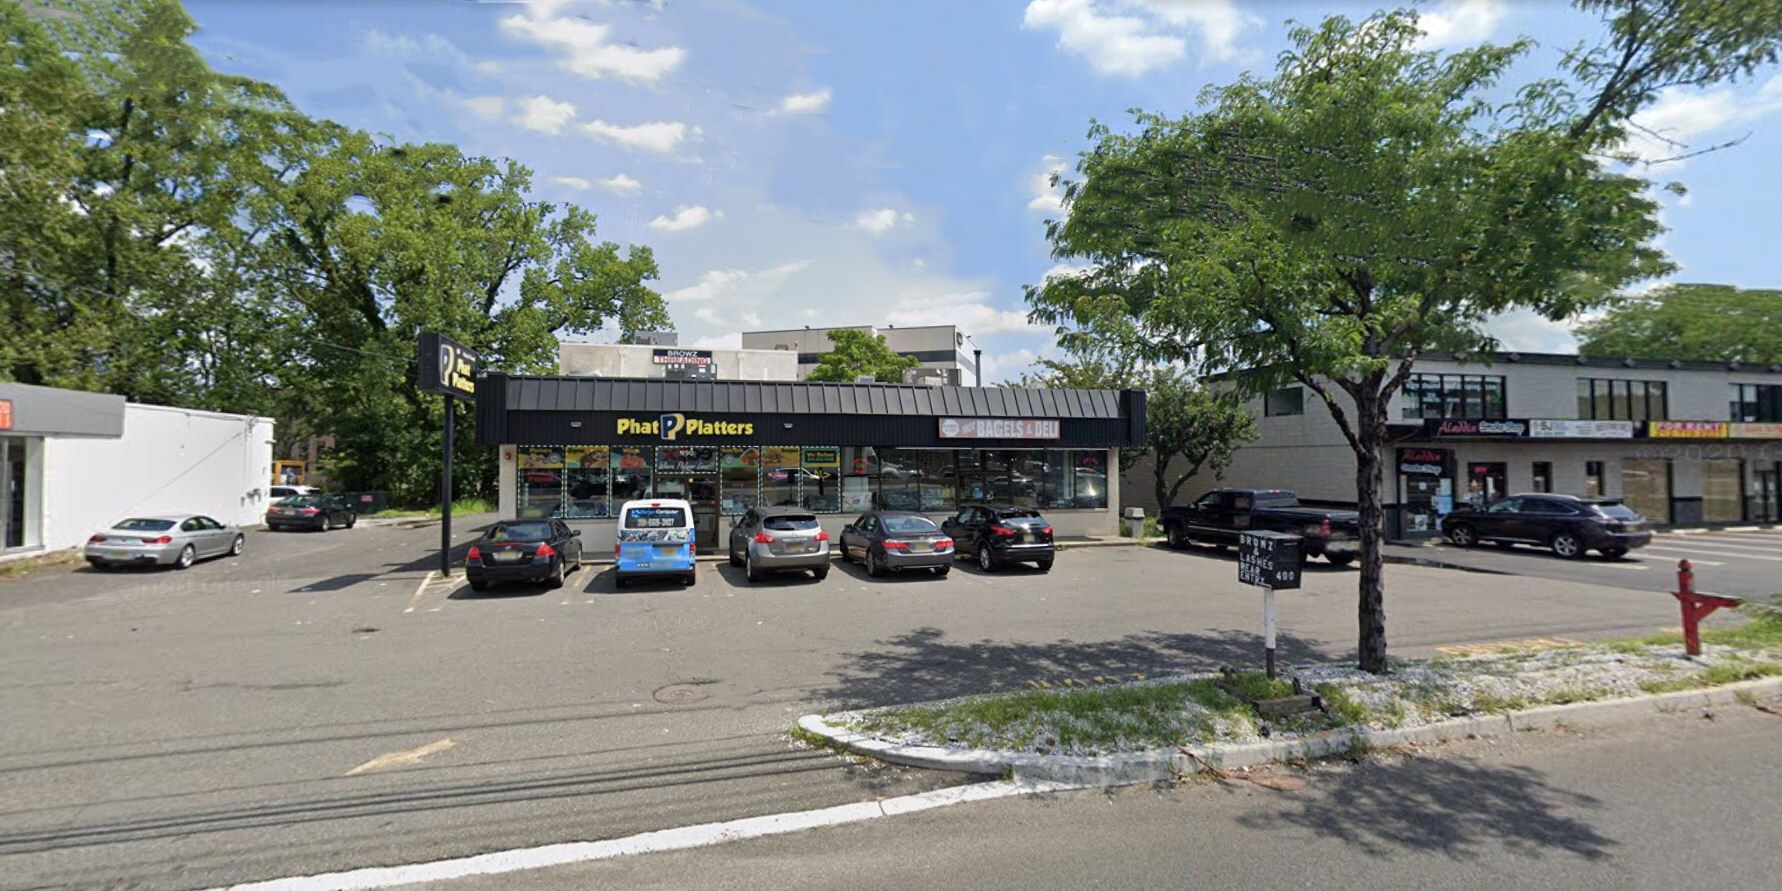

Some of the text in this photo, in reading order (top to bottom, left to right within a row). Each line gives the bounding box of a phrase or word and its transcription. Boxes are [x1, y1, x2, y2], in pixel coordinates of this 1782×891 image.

[657, 355, 707, 365] THREADING
[667, 350, 698, 358] BROWZ
[457, 358, 471, 376] Phat
[452, 371, 475, 393] Platters
[617, 413, 753, 440] Phat P Platters
[976, 420, 1024, 438] BAGELS
[1026, 423, 1033, 434] &
[1034, 420, 1059, 437] DELI
[1240, 534, 1274, 551] BROWZ
[1253, 547, 1260, 556] &
[1240, 551, 1273, 570] LASHES
[1240, 561, 1260, 575] REAR
[1240, 570, 1265, 584] ENTRY
